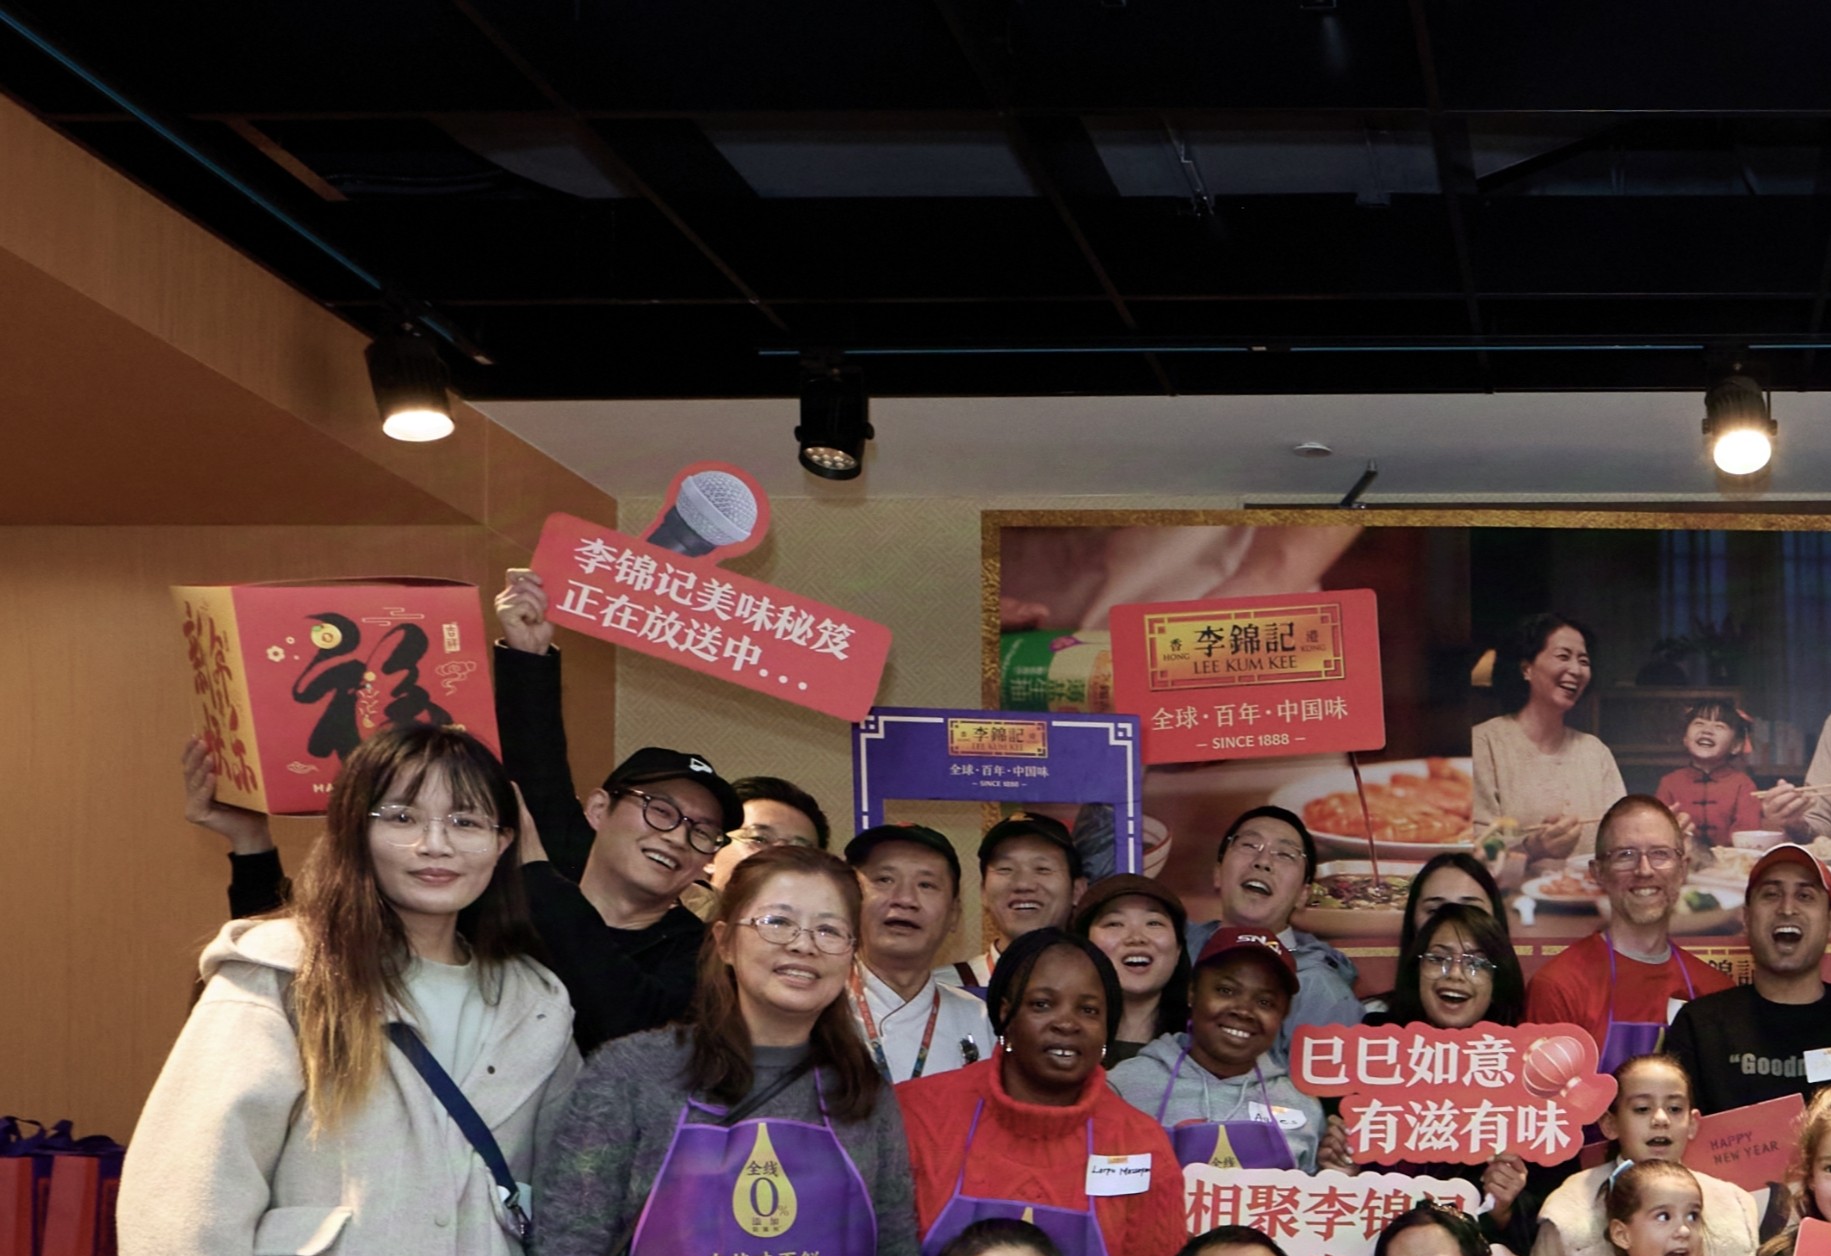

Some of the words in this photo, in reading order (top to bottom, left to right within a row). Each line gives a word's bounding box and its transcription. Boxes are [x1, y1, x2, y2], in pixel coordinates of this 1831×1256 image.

[574, 537, 857, 661] 李锦记美味秘笈
[1170, 638, 1183, 651] 香
[1194, 622, 1296, 657] 李錦記
[1163, 653, 1190, 661] HONG
[1193, 659, 1220, 675] LEE
[1226, 656, 1264, 672] KUM
[1269, 655, 1297, 670] KEE
[1212, 735, 1254, 749] SINCE
[1258, 733, 1290, 746] 1888
[1350, 1099, 1570, 1153] 有滋有味
[1710, 1131, 1753, 1151] HAPPY
[1714, 1151, 1740, 1164] NEW
[1745, 1140, 1778, 1156] YEAR
[747, 1161, 778, 1177] 全线
